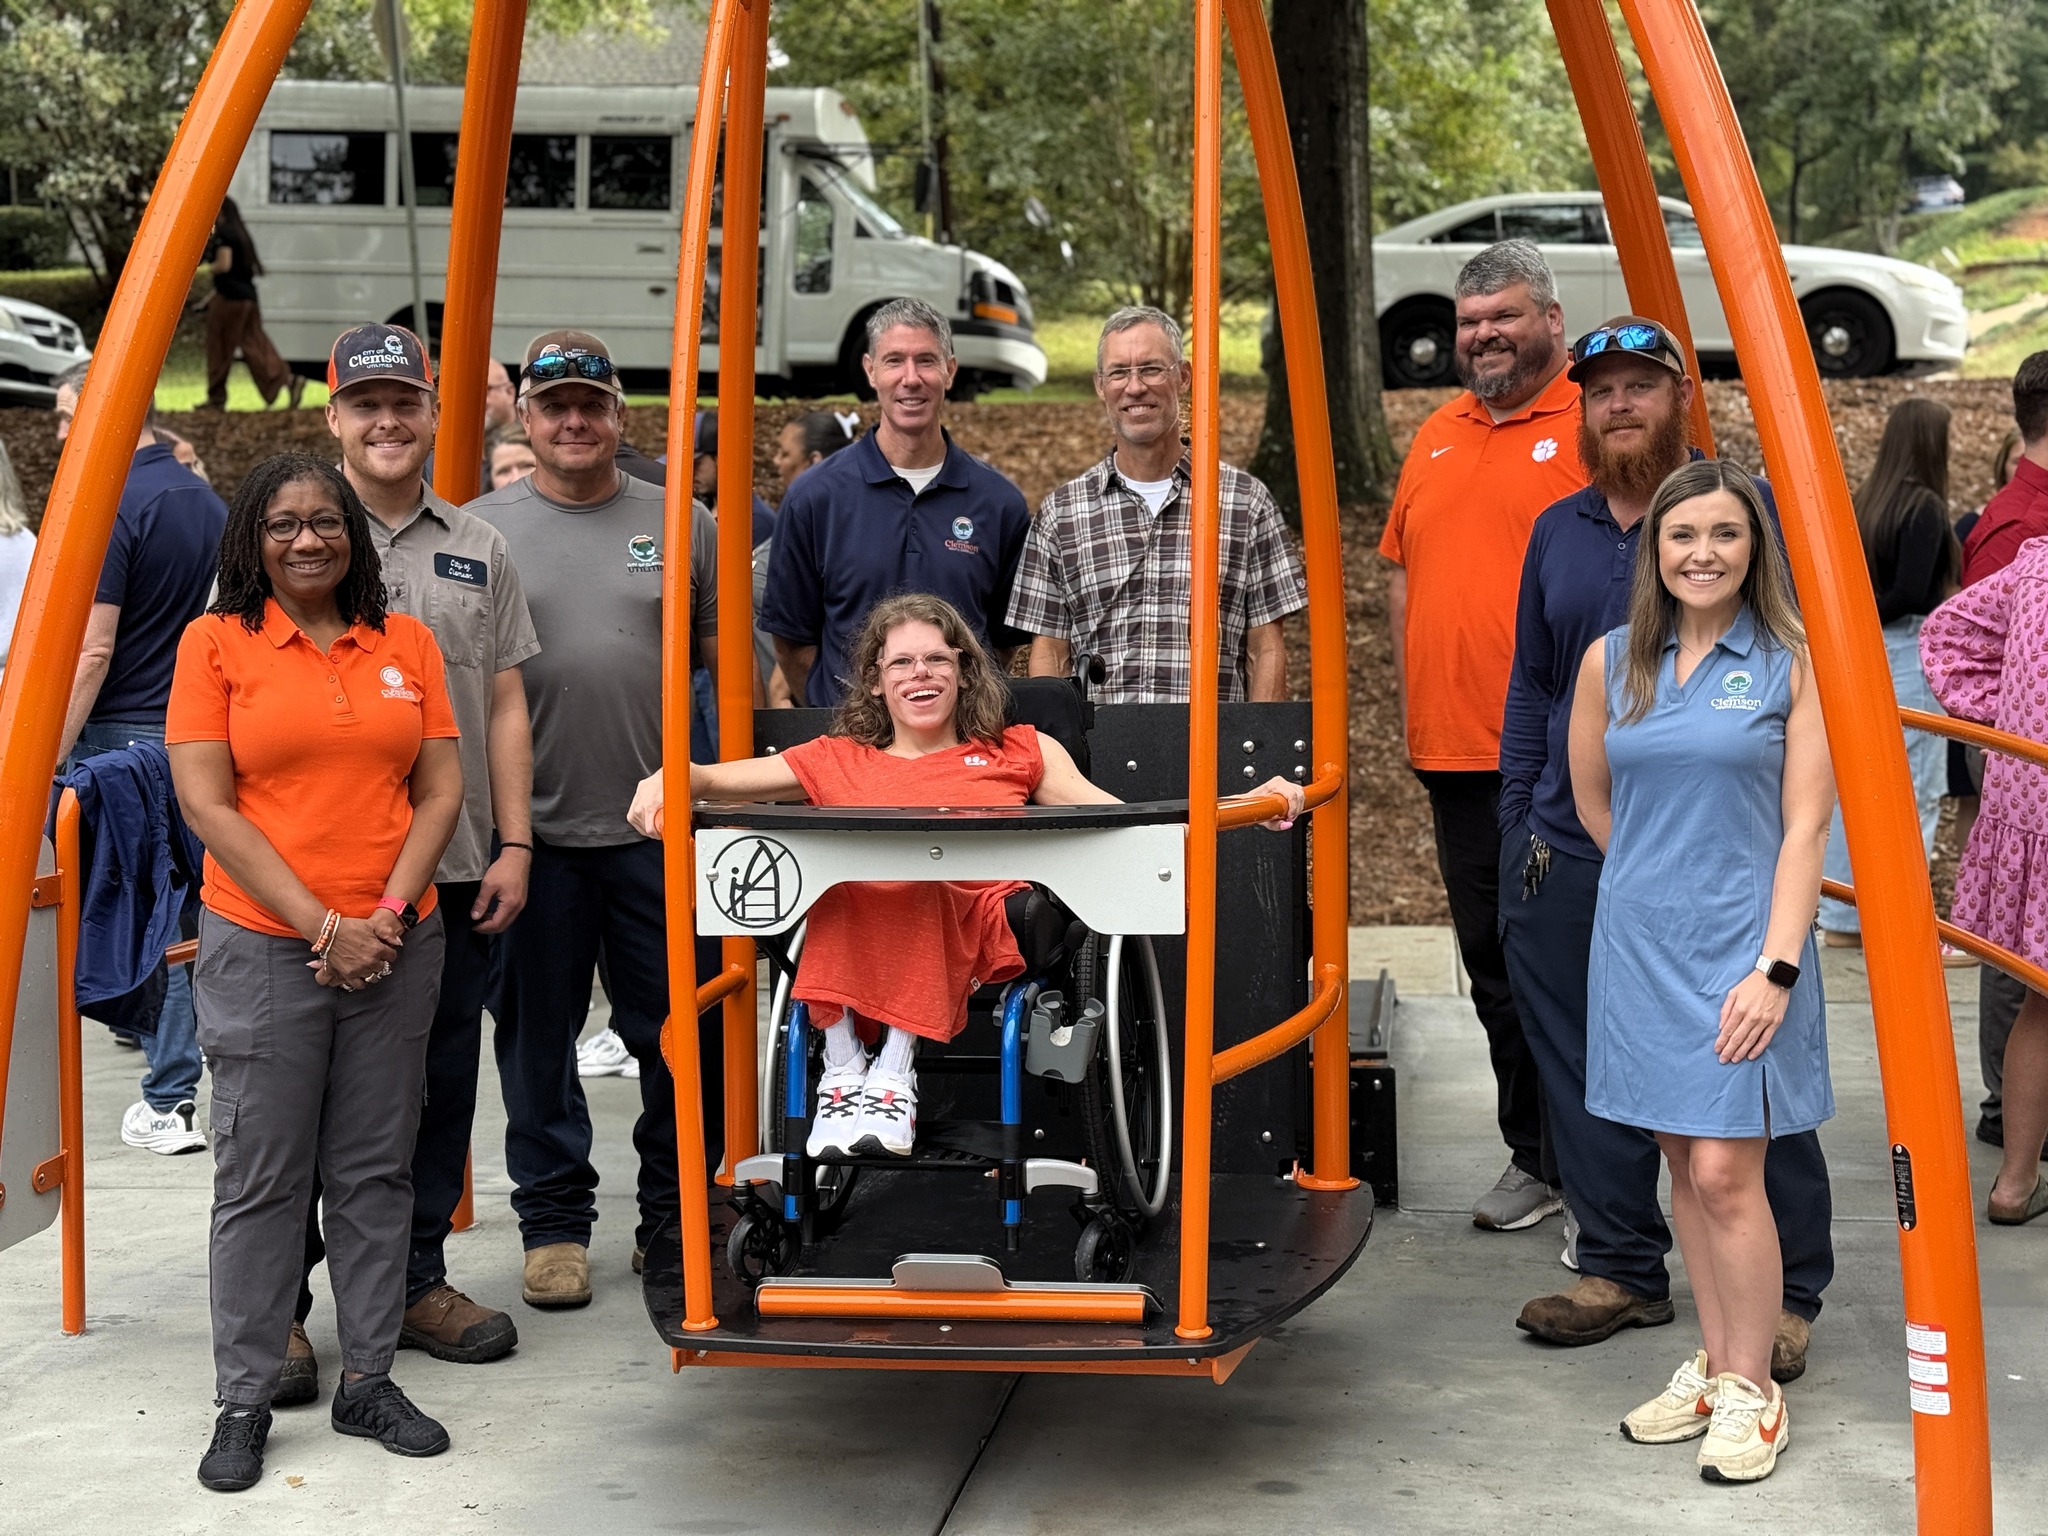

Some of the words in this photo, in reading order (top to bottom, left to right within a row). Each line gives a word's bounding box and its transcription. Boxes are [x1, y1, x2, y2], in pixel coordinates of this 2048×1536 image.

[348, 353, 409, 368] Clemson
[944, 539, 979, 553] Clemson
[1710, 697, 1762, 708] Clemson
[150, 1118, 178, 1133] HOKA
